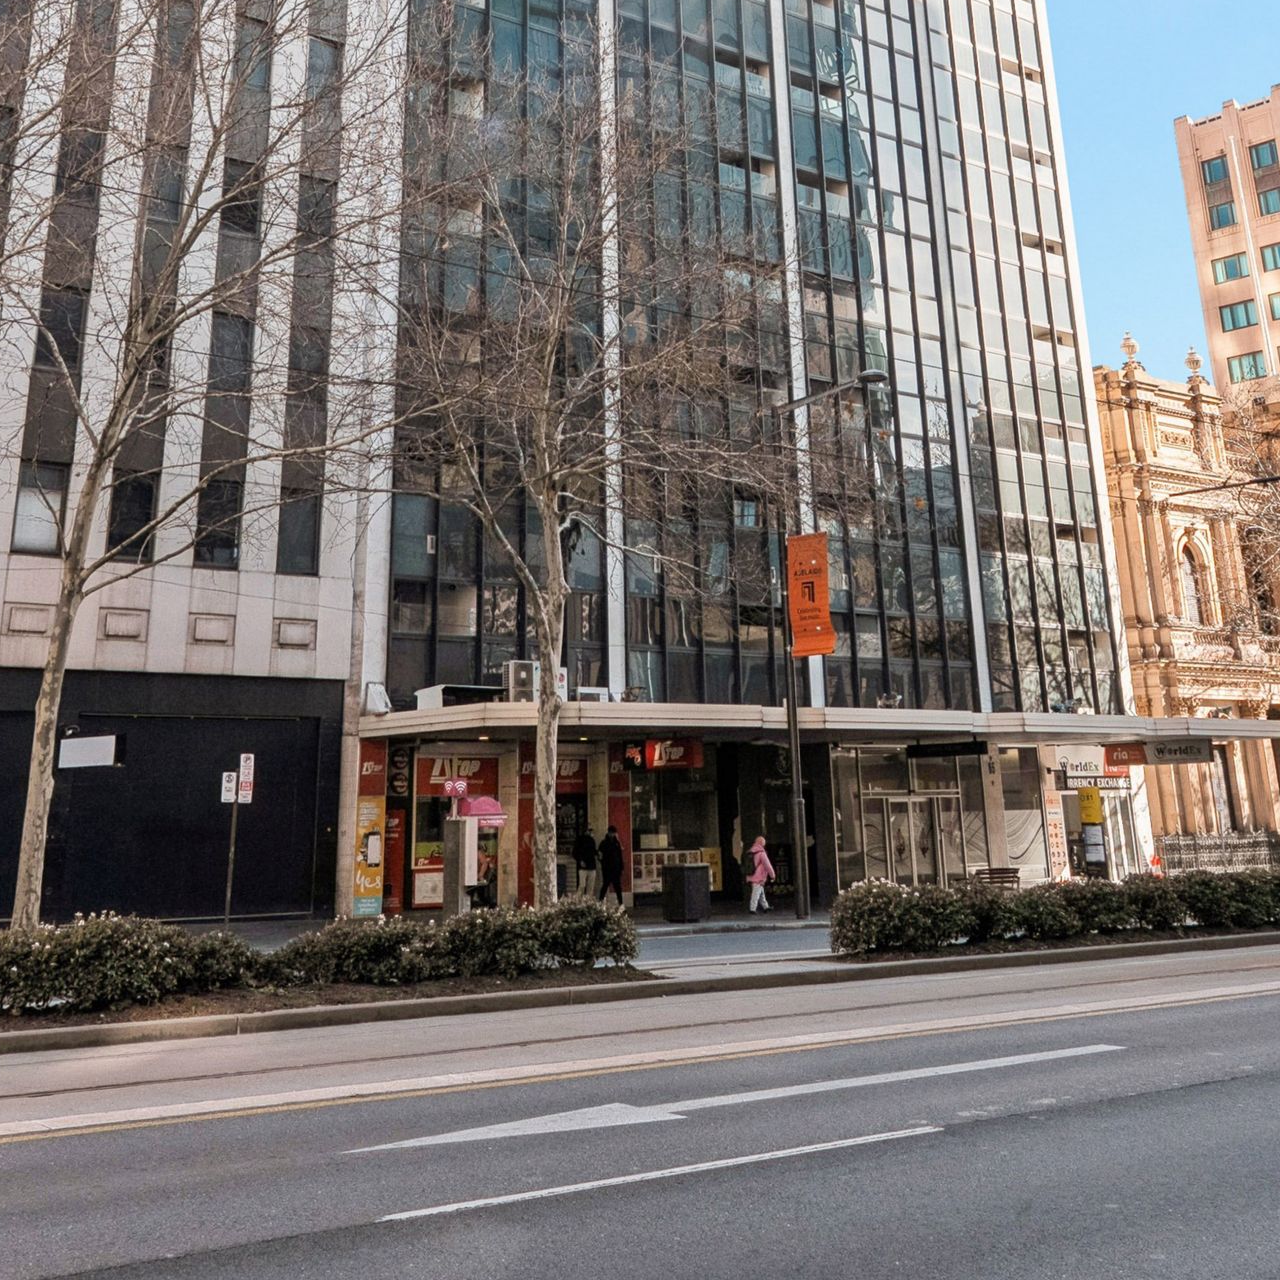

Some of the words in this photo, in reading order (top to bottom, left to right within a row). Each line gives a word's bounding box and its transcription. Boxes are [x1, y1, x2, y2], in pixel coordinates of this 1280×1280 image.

[1113, 748, 1129, 760] ria
[1156, 742, 1202, 757] WorldEx
[1059, 761, 1099, 773] WorldEx
[1067, 778, 1095, 789] RRENCY
